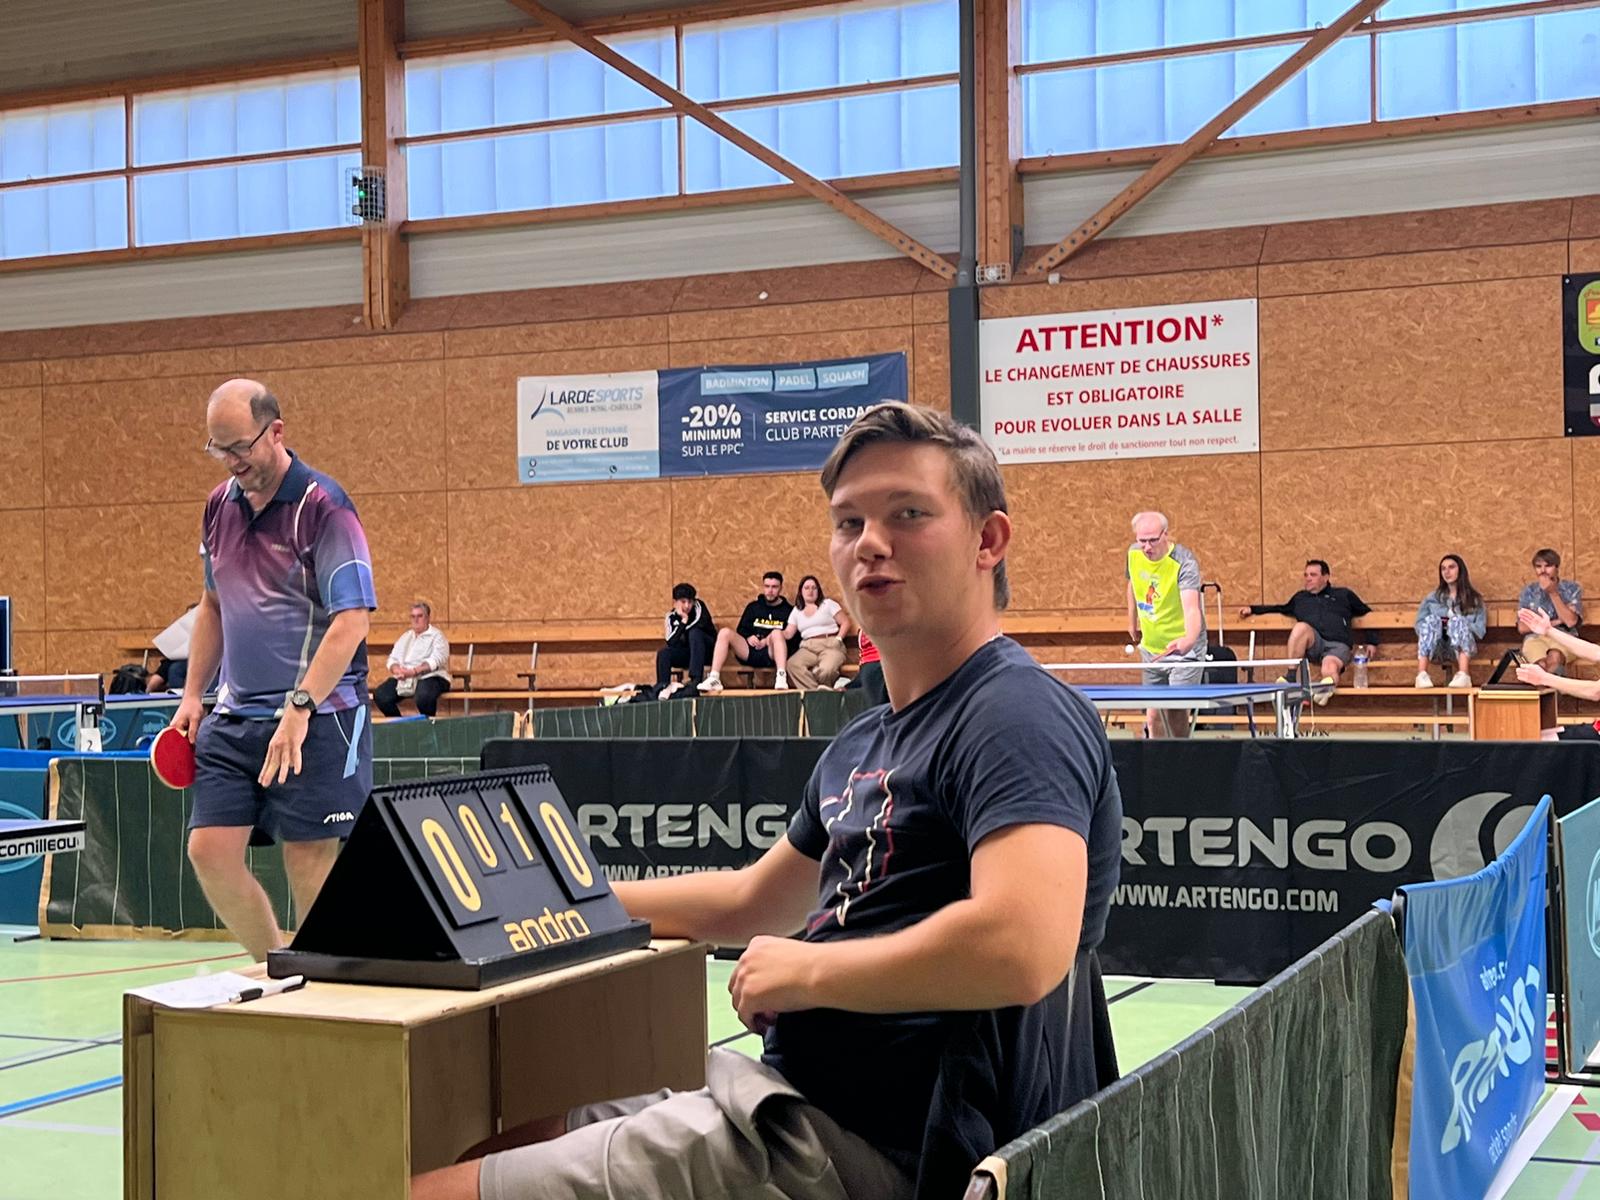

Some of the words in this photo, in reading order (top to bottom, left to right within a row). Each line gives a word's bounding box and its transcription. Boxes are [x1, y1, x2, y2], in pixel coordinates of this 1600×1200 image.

[985, 369, 1002, 383] LE
[1007, 361, 1115, 382] CHANGEMENT
[1120, 359, 1141, 374] DE
[1145, 352, 1250, 373] CHAUSSURES
[706, 377, 769, 389] BADMINTON
[779, 374, 811, 386] PADEL
[823, 369, 866, 384] SQUASH
[1047, 391, 1072, 406] EST
[1079, 384, 1185, 404] OBLIGATOIRE
[681, 404, 742, 428] -20%
[765, 409, 816, 425] SERVICE
[994, 420, 1036, 435] POUR
[1042, 415, 1112, 433] EVOLUER
[1118, 412, 1161, 429] DANS
[1166, 411, 1187, 426] LA
[1193, 408, 1243, 425] SALLE
[547, 440, 560, 451] DE
[562, 438, 598, 450] VOTRE
[600, 437, 629, 448] CLUB
[682, 428, 741, 442] MINIMUM
[765, 428, 800, 442] CLUB
[682, 445, 703, 457] SUR
[706, 444, 718, 456] LE
[1013, 446, 1037, 455] mairie
[1078, 442, 1086, 452] le
[1087, 441, 1107, 451] droit
[1109, 440, 1119, 450] de
[1121, 439, 1167, 449] sanctionner
[1169, 437, 1187, 447] tout
[1189, 438, 1205, 447] non
[421, 819, 482, 912] 0
[458, 804, 498, 868] 0
[500, 802, 534, 862] 1
[539, 802, 594, 888] 0
[504, 907, 591, 952] andro
